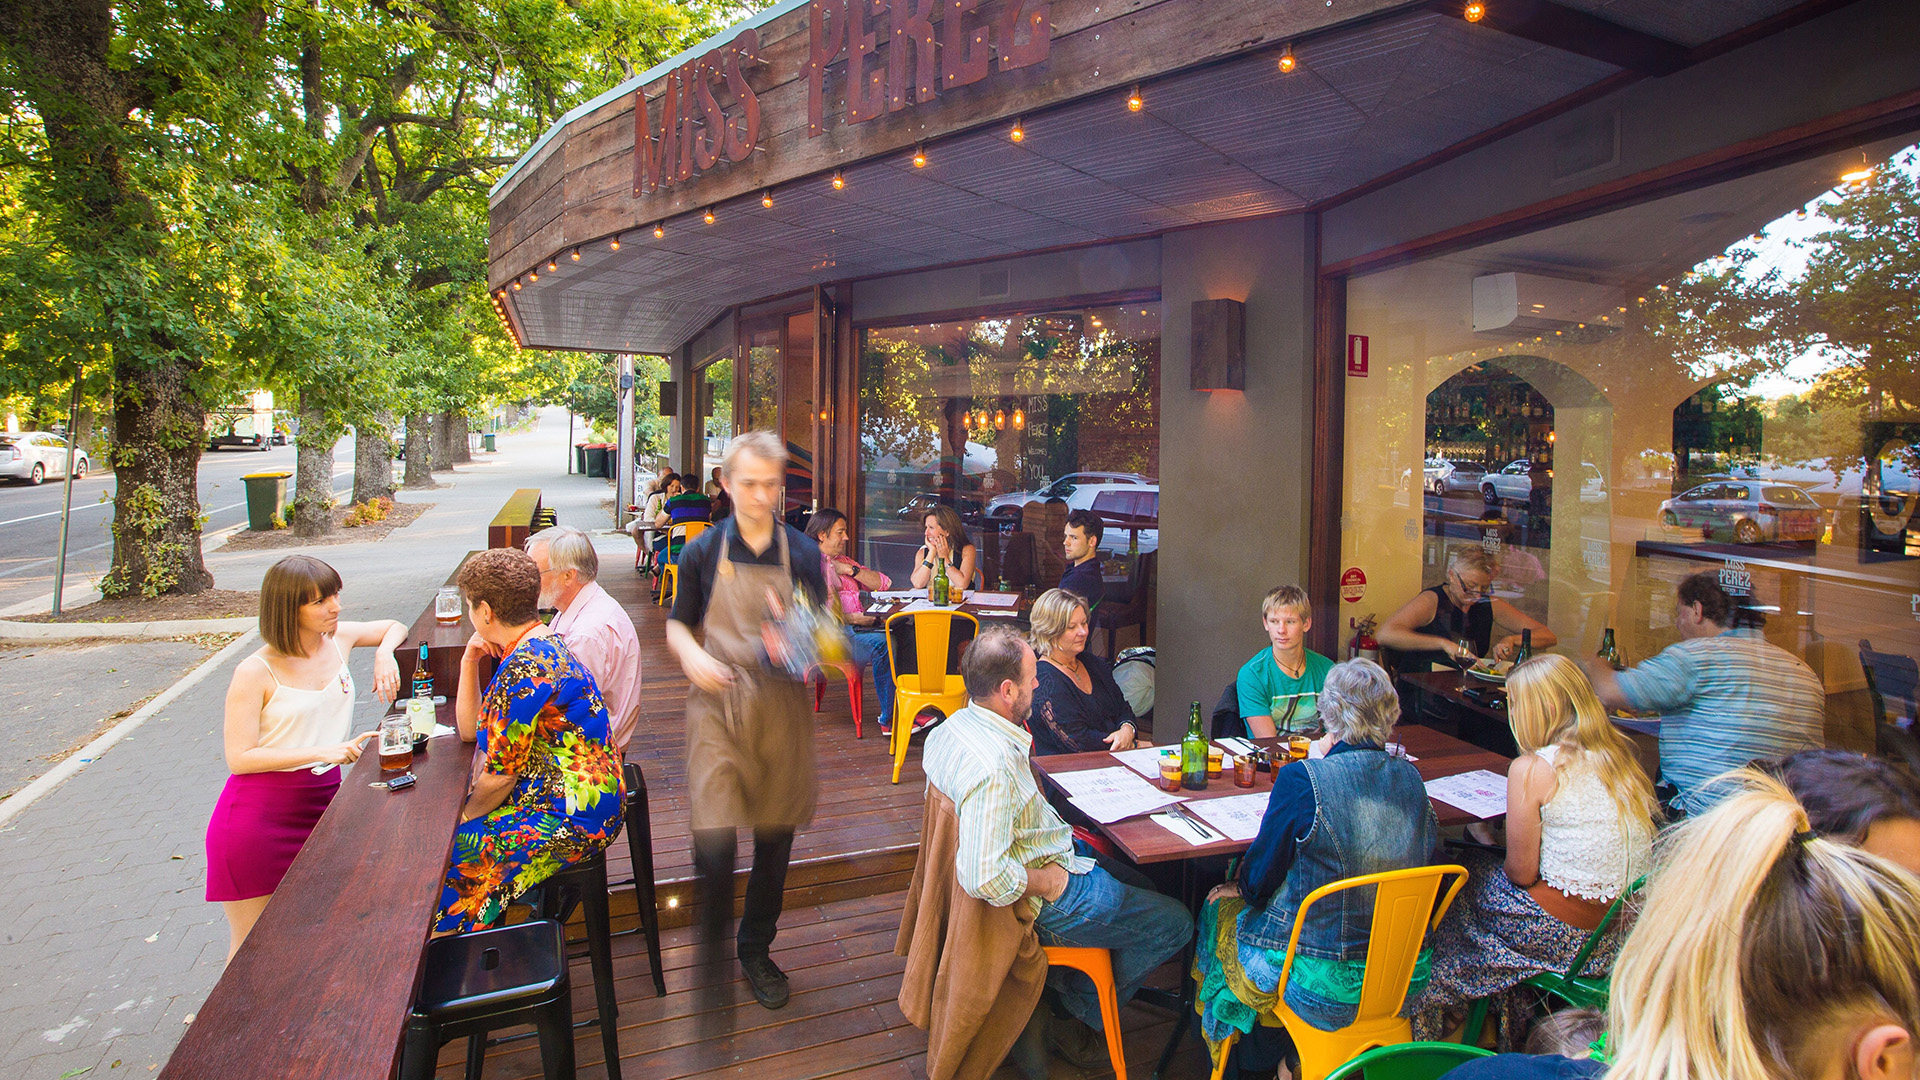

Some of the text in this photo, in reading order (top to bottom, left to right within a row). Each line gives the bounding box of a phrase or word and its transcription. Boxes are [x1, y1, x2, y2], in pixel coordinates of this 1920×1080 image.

[632, 28, 760, 199] MISS
[1028, 395, 1048, 414] MISS
[1028, 421, 1048, 438] PEREZ
[1029, 464, 1045, 480] YOU
[1486, 528, 1498, 537] MISS
[1483, 536, 1501, 550] PEREZ
[1588, 540, 1602, 551] MISS
[1583, 550, 1608, 566] PEREZ
[1725, 558, 1745, 570] MISS
[1719, 569, 1751, 588] PEREZ
